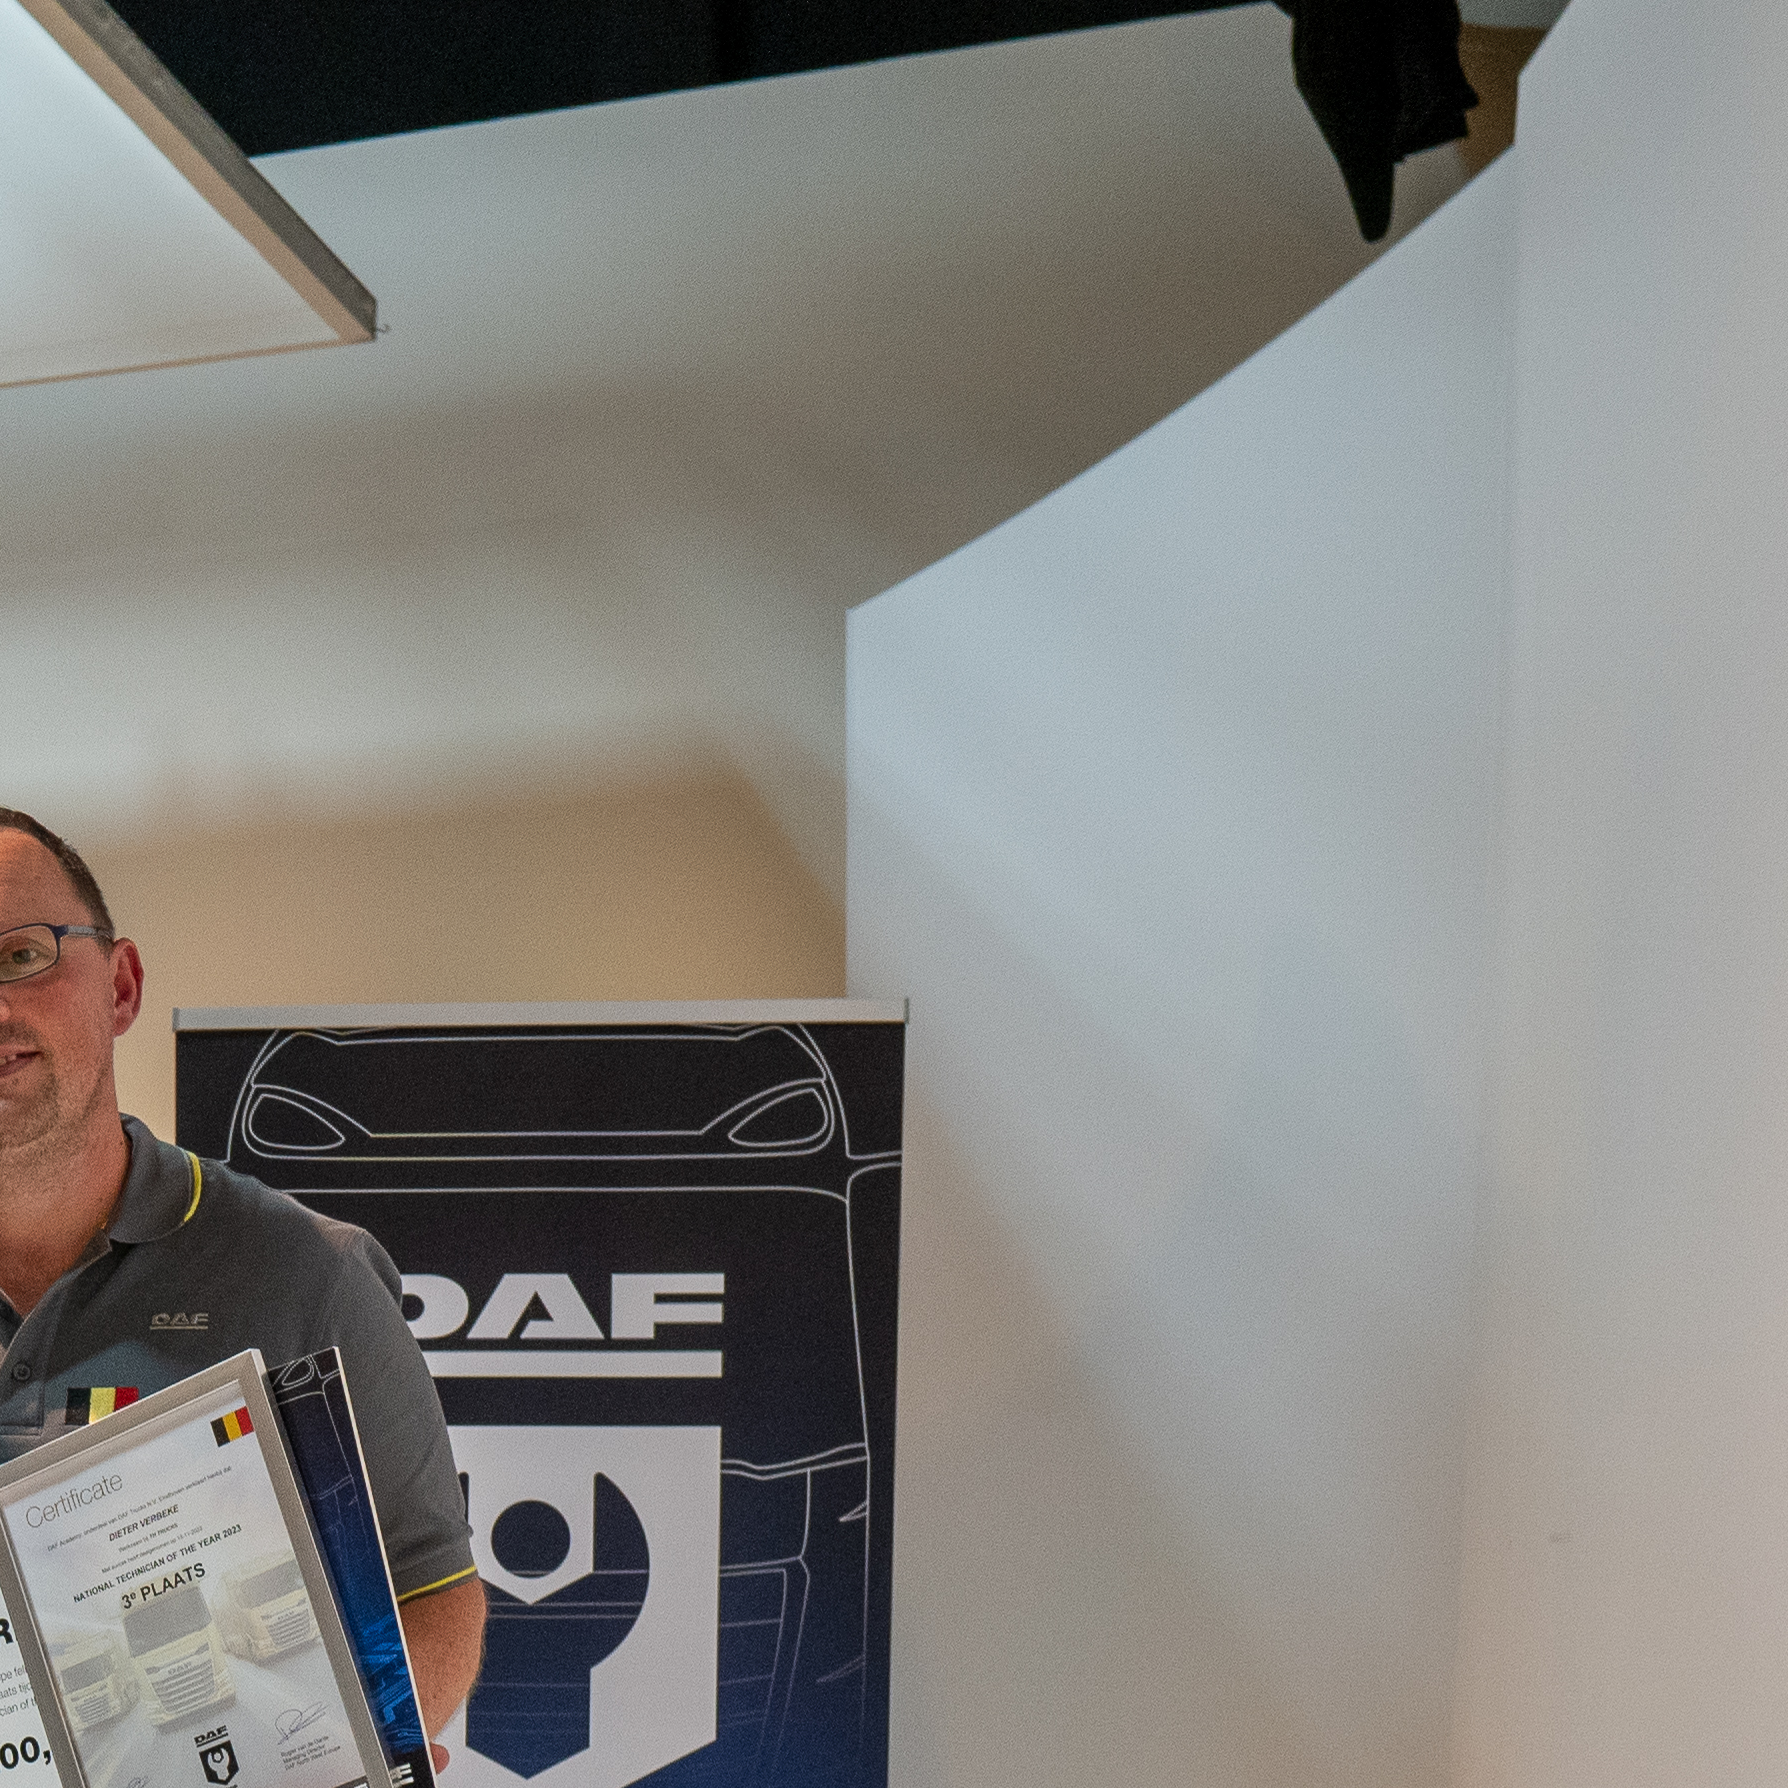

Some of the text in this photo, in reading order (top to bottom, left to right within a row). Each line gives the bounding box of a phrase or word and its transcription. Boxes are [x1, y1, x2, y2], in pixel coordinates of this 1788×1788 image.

[151, 1313, 209, 1326] DAF
[400, 1273, 724, 1340] DAF
[25, 1474, 123, 1528] Certificate
[108, 1522, 139, 1542] DIETER
[139, 1504, 180, 1528] VERBEKE
[73, 1581, 115, 1603] NATIONAL
[116, 1558, 166, 1585] TECHNICIAN
[166, 1550, 179, 1563] OF
[179, 1543, 197, 1558] THE
[197, 1532, 222, 1549] YEAR
[222, 1523, 243, 1539] 2023
[122, 1593, 137, 1610] 3e
[140, 1562, 206, 1602] PLAATS
[19, 1698, 31, 1712] of
[194, 1725, 227, 1744] DAF
